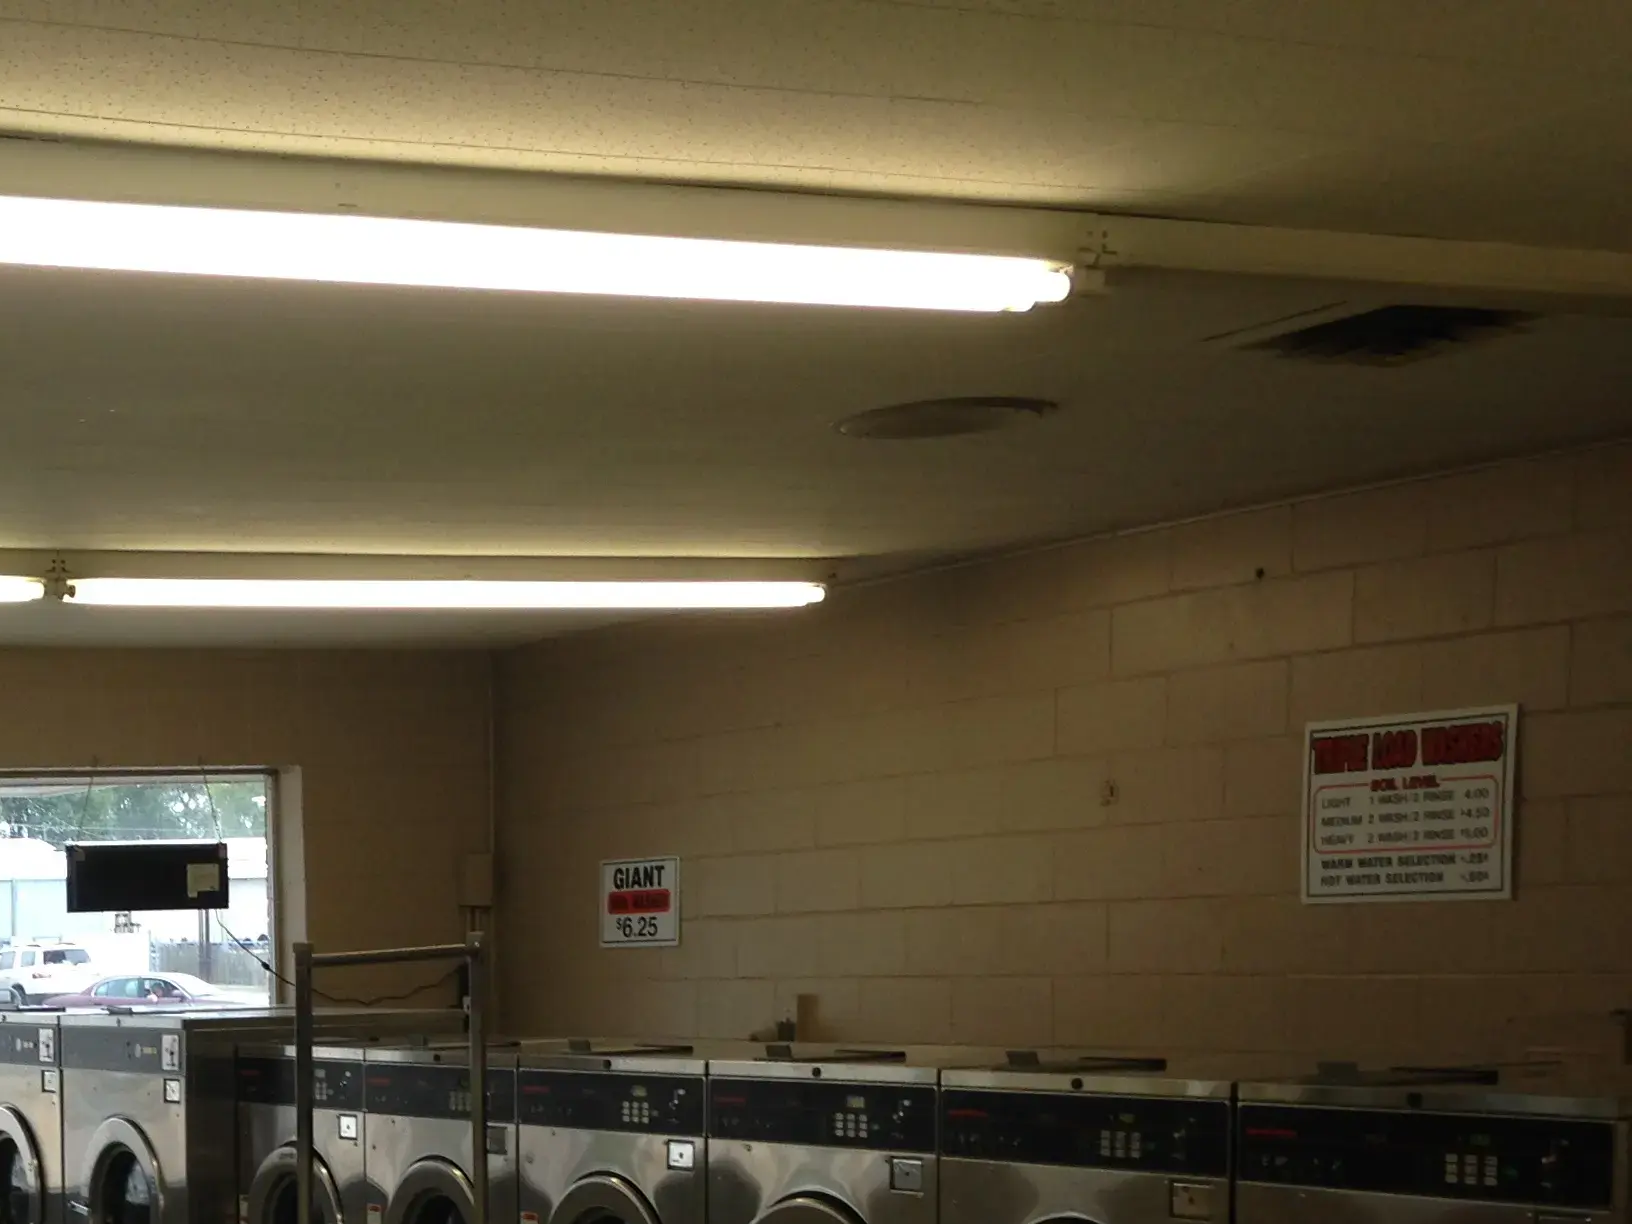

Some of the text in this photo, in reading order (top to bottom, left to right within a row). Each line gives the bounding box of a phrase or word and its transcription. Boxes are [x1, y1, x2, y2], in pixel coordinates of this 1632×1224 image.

[1371, 729, 1418, 770] LOAD
[1321, 815, 1362, 827] MEDIUM
[1321, 858, 1353, 870] WARM
[1357, 856, 1393, 868] WATER
[1397, 853, 1456, 868] SELECTION
[613, 865, 665, 890] GIANT
[1346, 873, 1381, 886] WATER
[1385, 871, 1444, 884] SELECTION
[615, 915, 659, 939] $6.25
